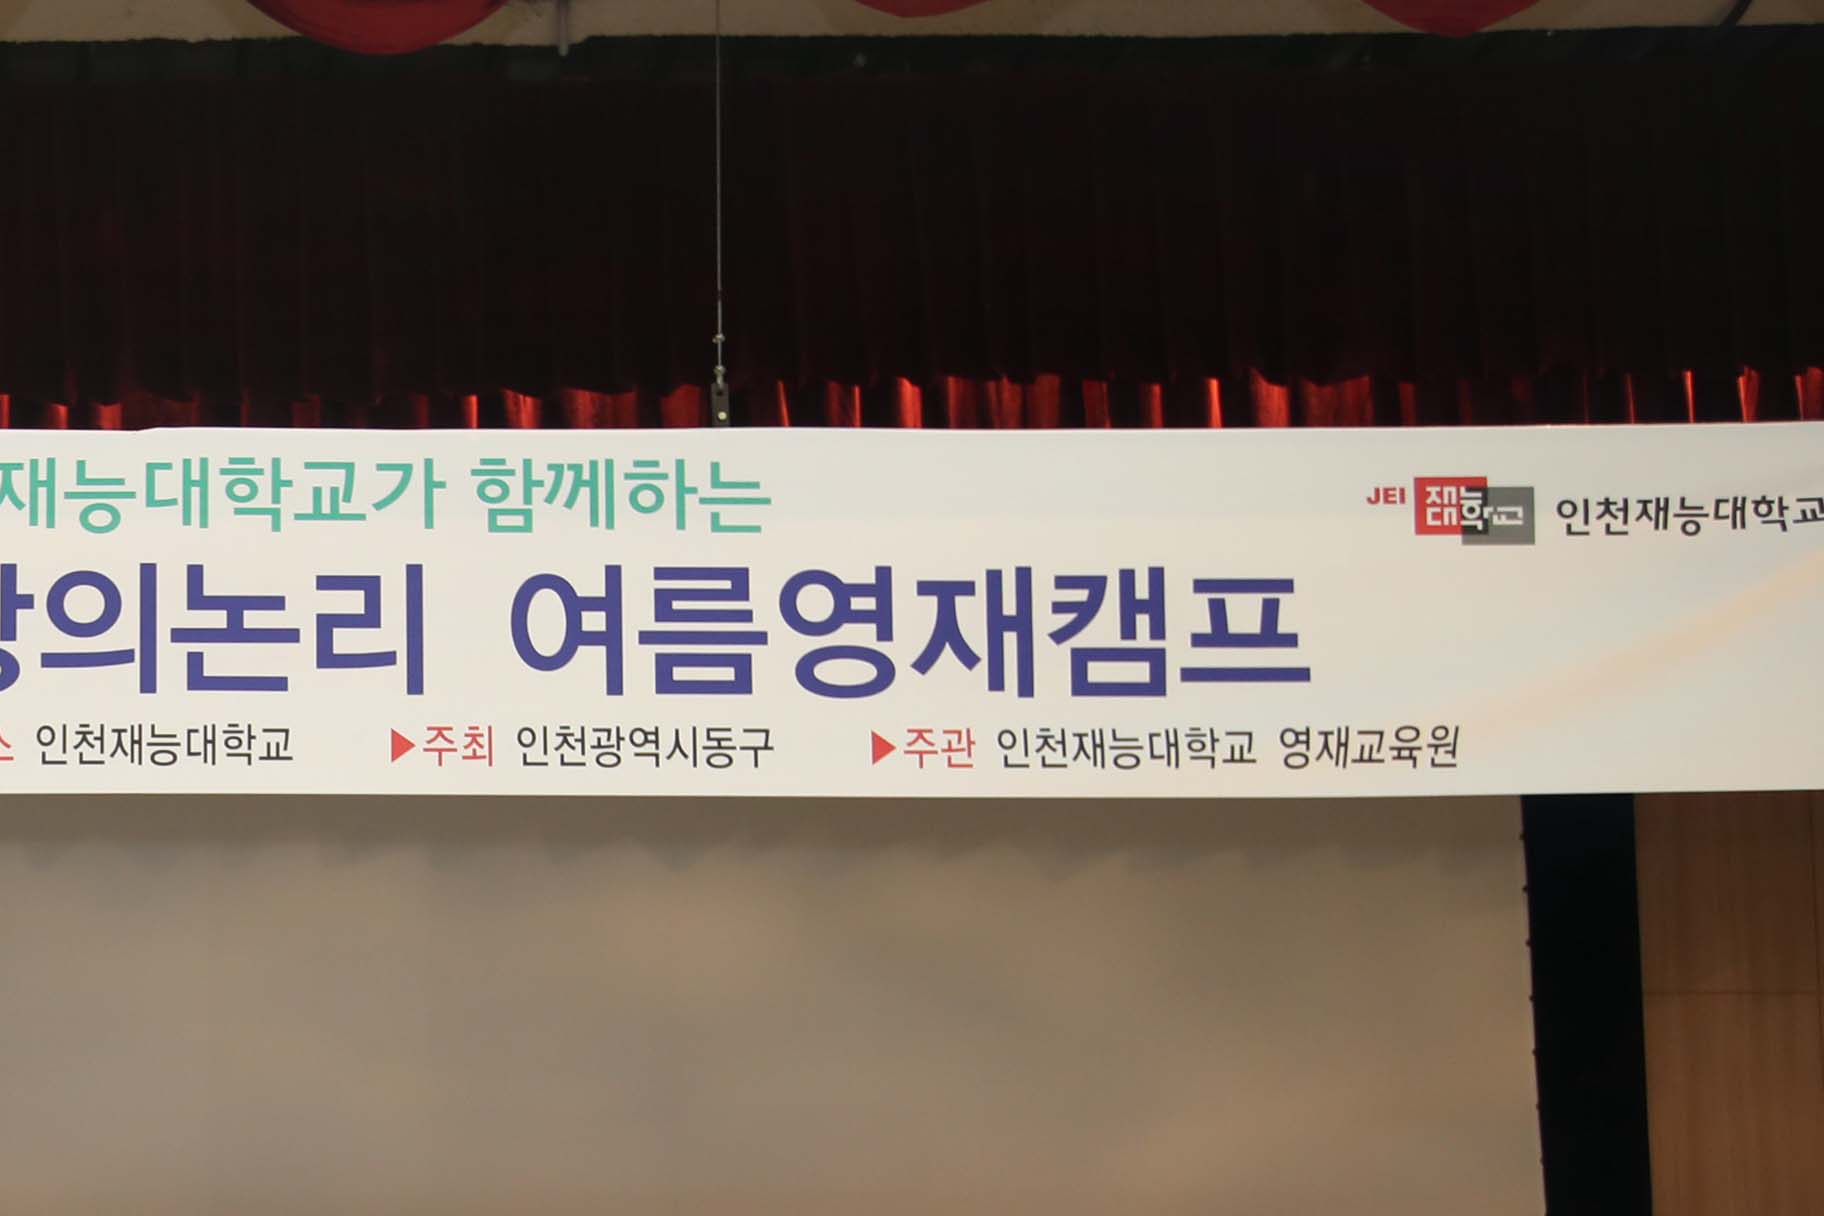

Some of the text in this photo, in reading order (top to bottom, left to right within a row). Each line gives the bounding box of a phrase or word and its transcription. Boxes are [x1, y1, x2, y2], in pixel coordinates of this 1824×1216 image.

[469, 457, 773, 535] 함께하는
[1365, 486, 1407, 506] JEI
[1555, 493, 1824, 538] 인천재능대학교
[509, 563, 1313, 700] 여름영재캠프
[35, 722, 294, 767] 인천재능대학교
[422, 724, 776, 770] 주최 인천광역시동구
[902, 724, 1461, 771] 주관 인천재능대학교 영재교육원
